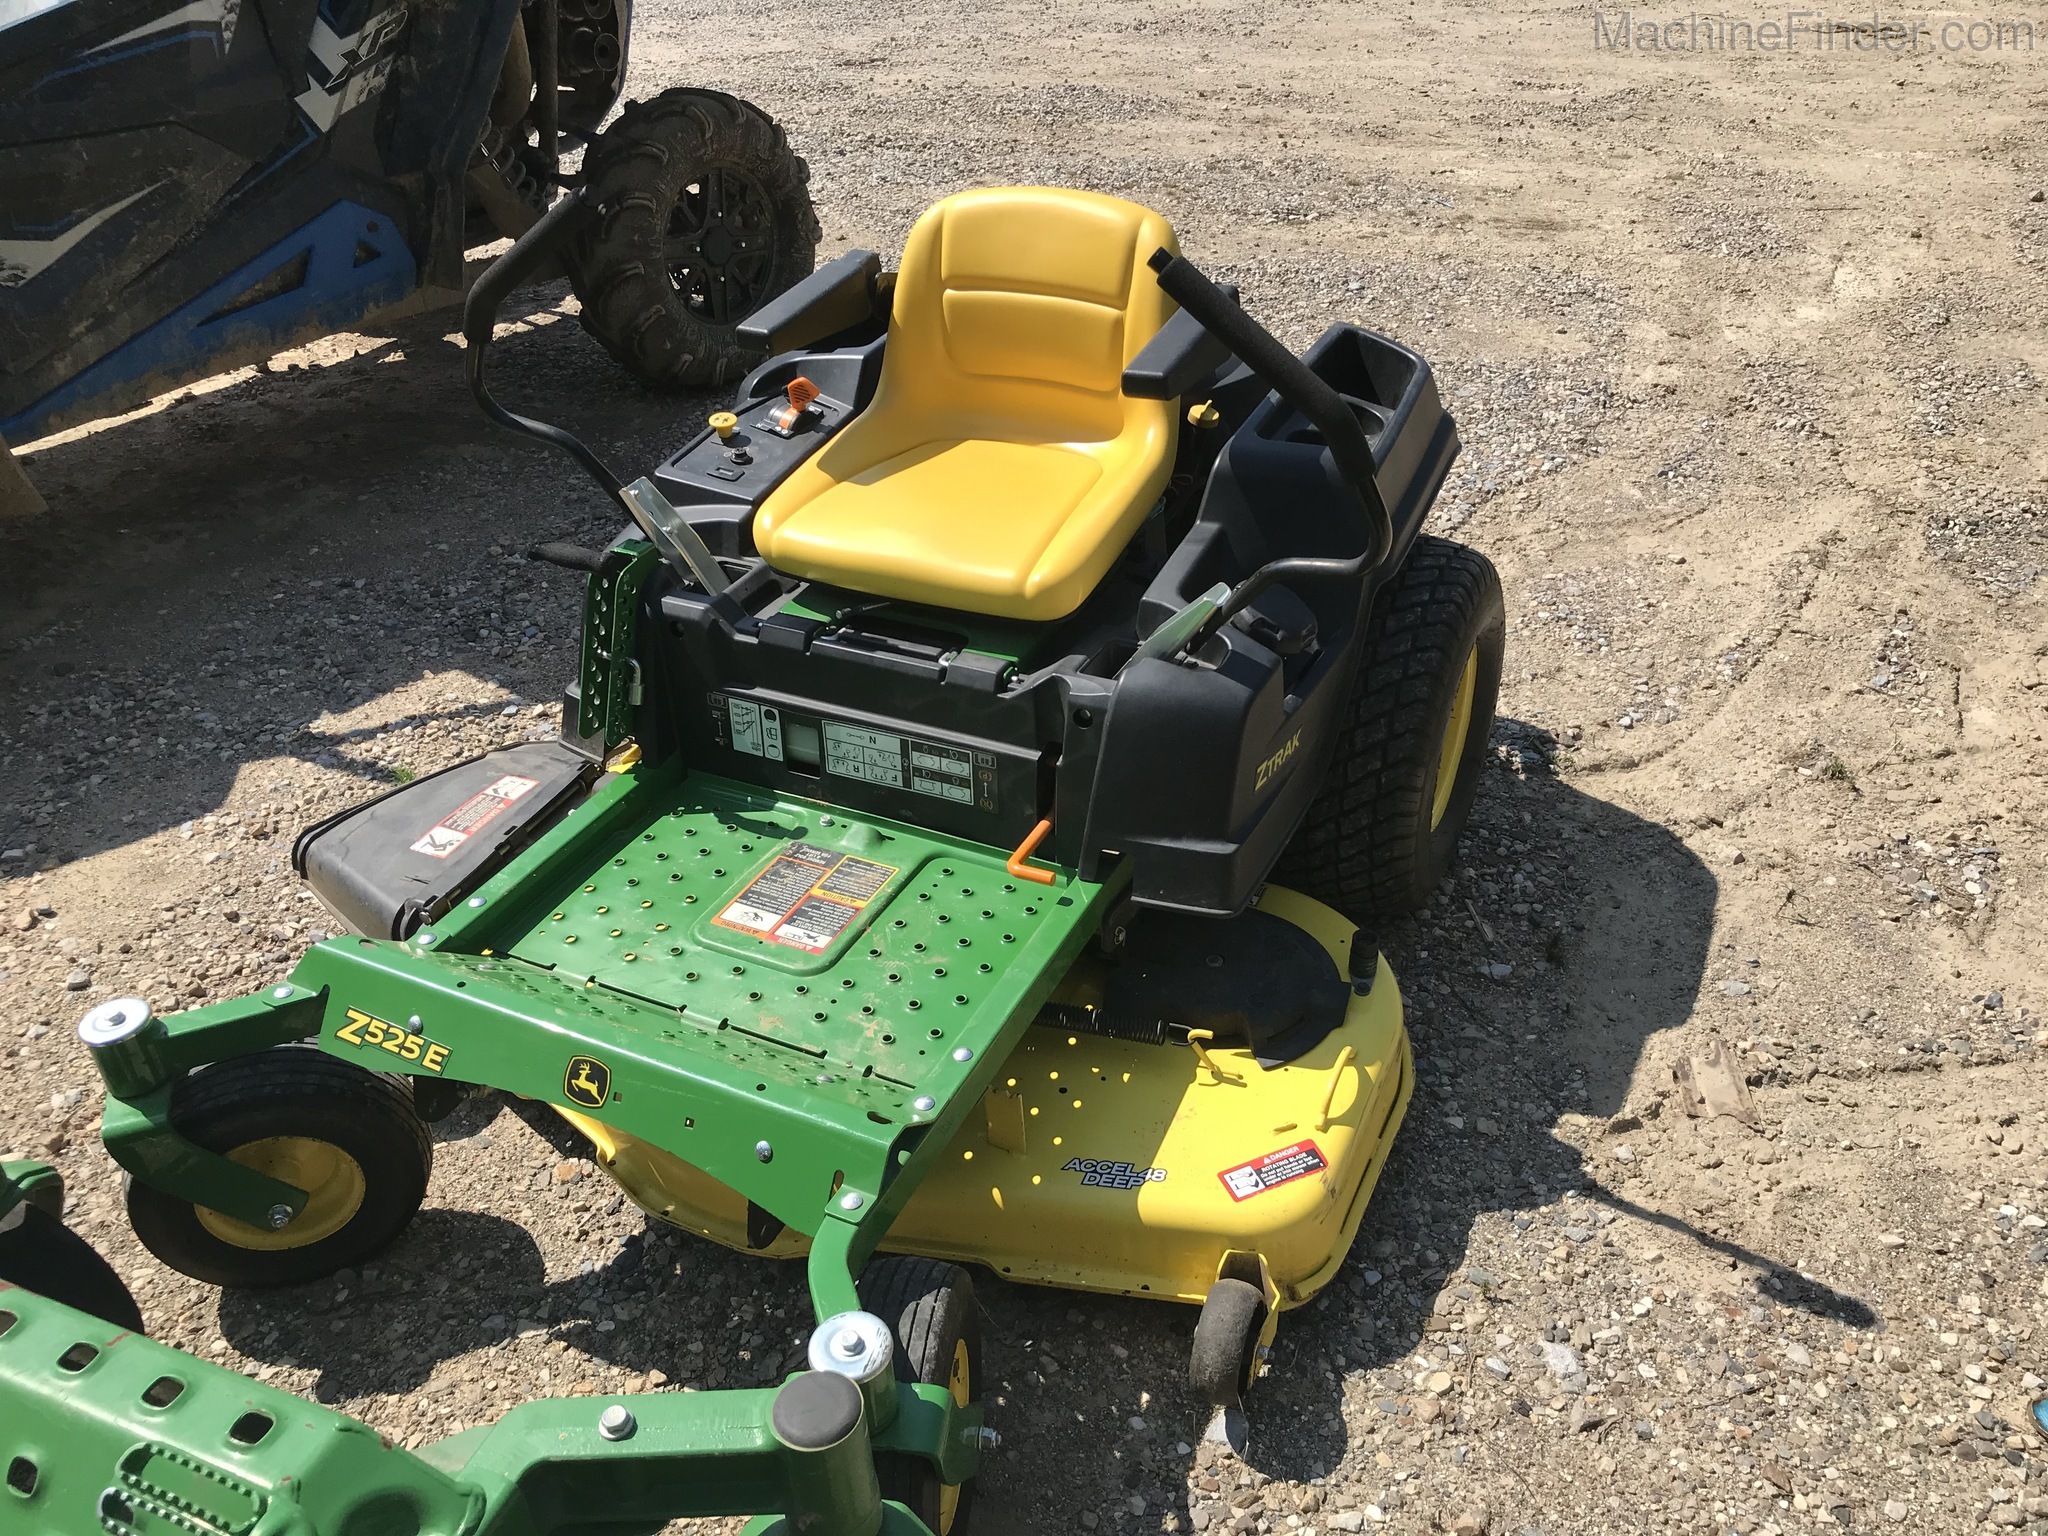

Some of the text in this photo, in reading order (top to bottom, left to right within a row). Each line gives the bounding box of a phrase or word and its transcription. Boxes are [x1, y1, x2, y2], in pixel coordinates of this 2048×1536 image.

[1254, 728, 1301, 792] ZTRAK
[821, 891, 850, 902] CAUTION
[777, 936, 806, 948] DANGER
[1269, 1146, 1300, 1160] DANGER
[1061, 1158, 1138, 1176] ACCEL
[1261, 1152, 1307, 1172] ROTATING BLADE
[1081, 1172, 1146, 1189] DEEP
